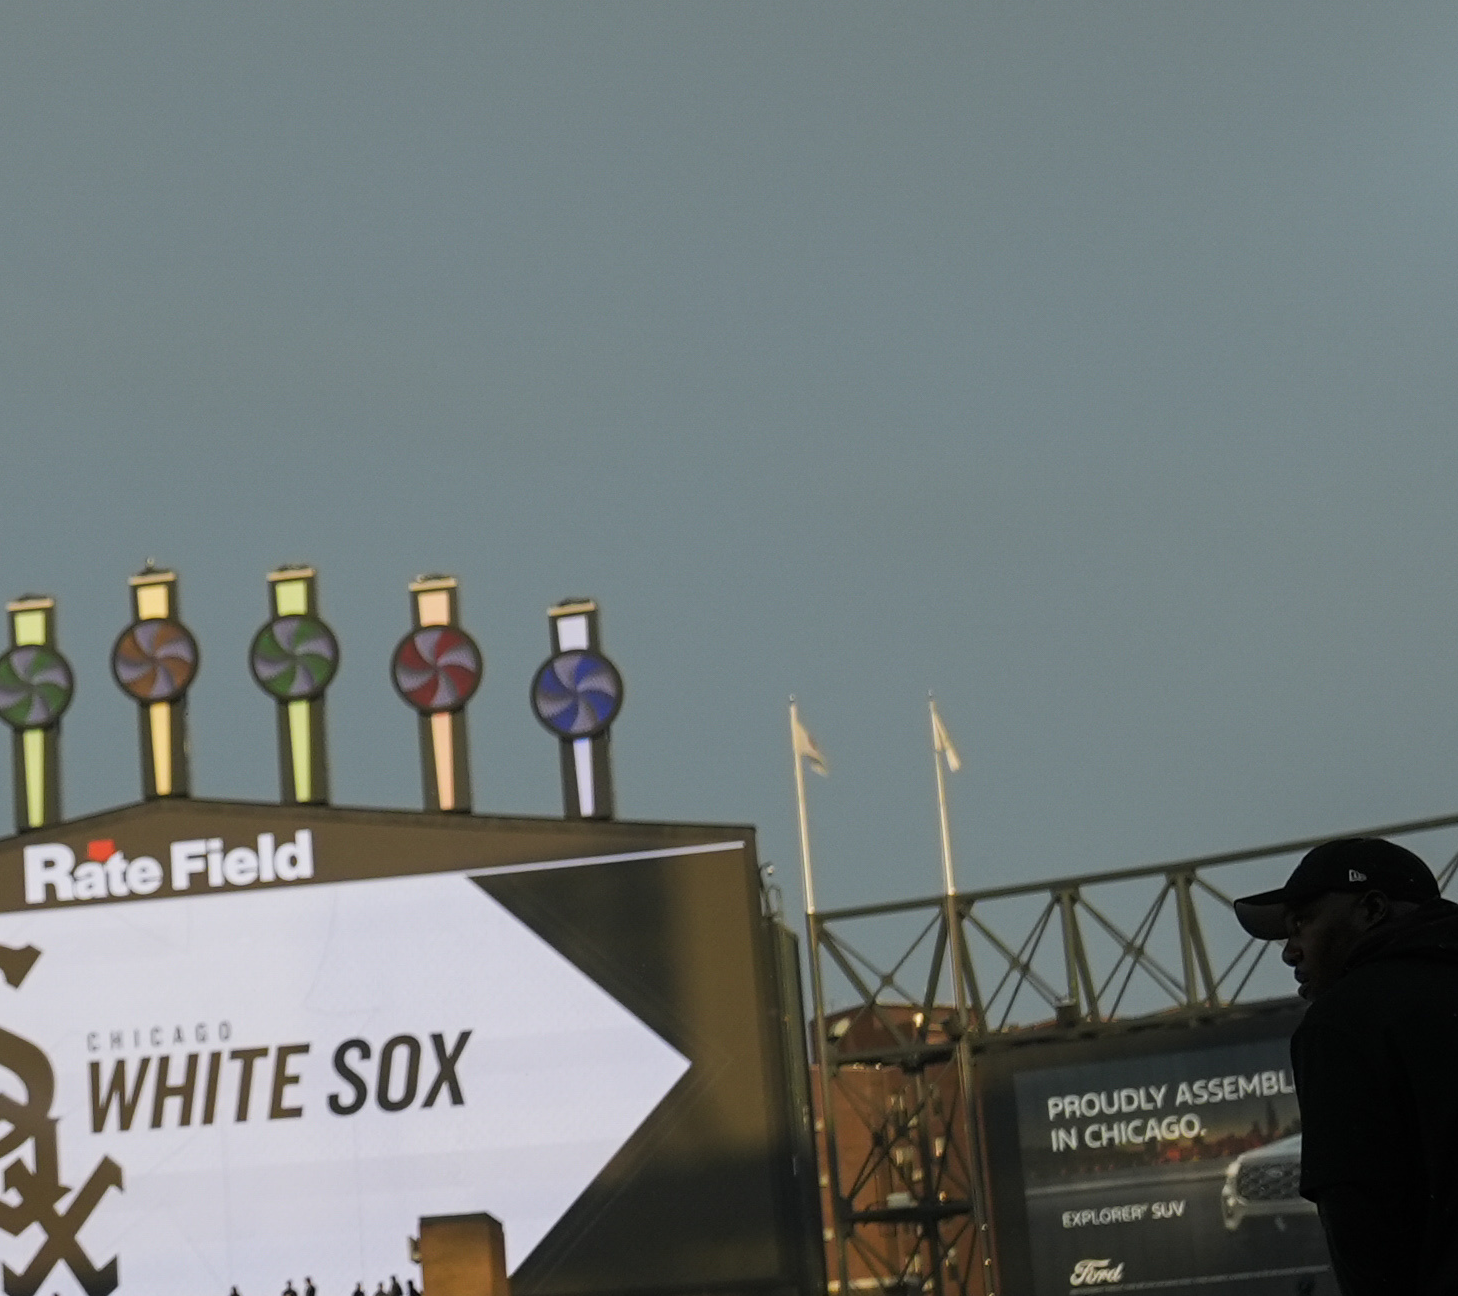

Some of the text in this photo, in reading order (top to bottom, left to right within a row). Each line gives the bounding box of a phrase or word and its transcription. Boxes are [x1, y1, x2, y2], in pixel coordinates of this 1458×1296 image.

[23, 828, 314, 904] Rate Field
[86, 1020, 233, 1052] CHICAGO
[88, 1029, 474, 1134] WHITE SOX
[1047, 1069, 1294, 1121] PROUDLY ASSEMBL
[1050, 1113, 1207, 1153] IN CHICAGO.
[1152, 1200, 1185, 1219] SUV
[1070, 1258, 1125, 1286] Ford
